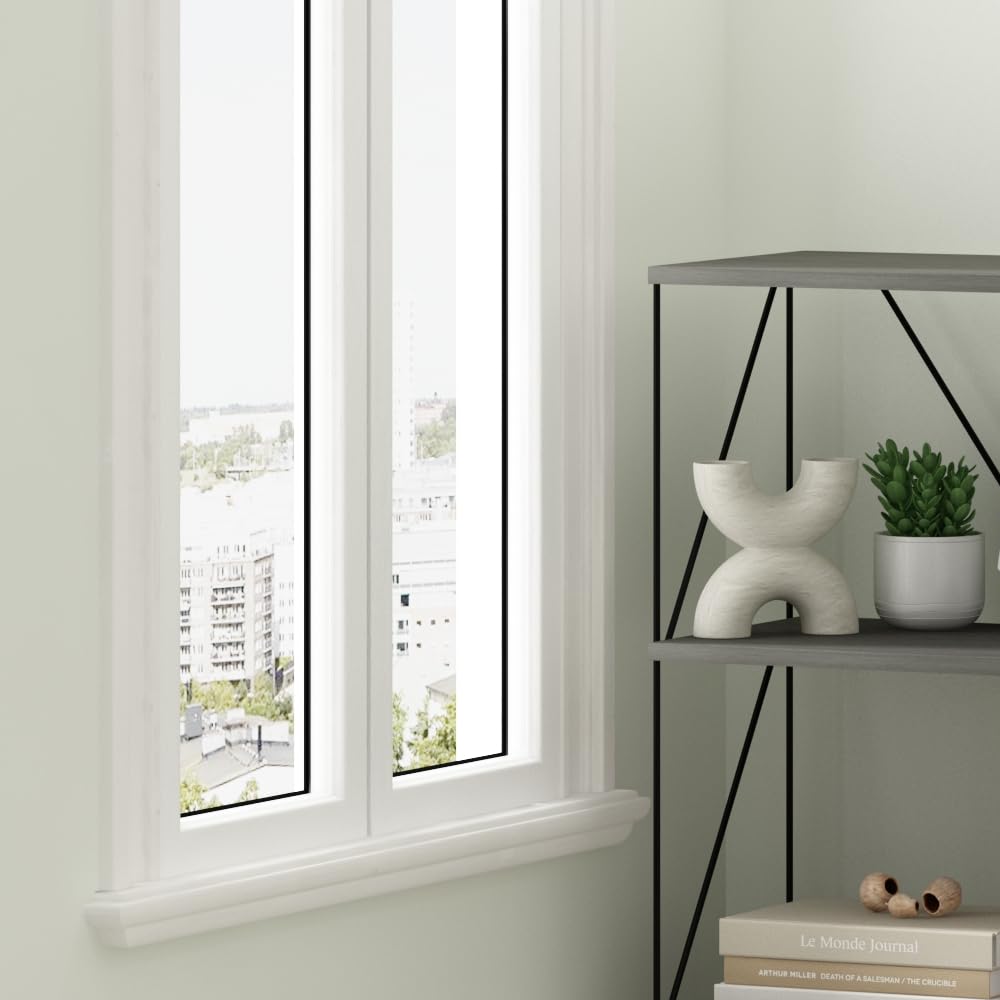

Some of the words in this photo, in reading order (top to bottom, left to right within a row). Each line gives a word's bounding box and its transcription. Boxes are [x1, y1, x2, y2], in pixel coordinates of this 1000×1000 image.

[800, 935, 816, 947] Le
[820, 935, 866, 951] Monde
[869, 938, 919, 953] Journal
[758, 968, 788, 978] ARTHUR
[790, 970, 817, 979] MILLER
[820, 972, 844, 981] DEATH
[845, 973, 855, 982] OF
[862, 975, 900, 985] SALESMAN
[906, 977, 920, 986] THE
[921, 978, 958, 988] CRUCIBLE
